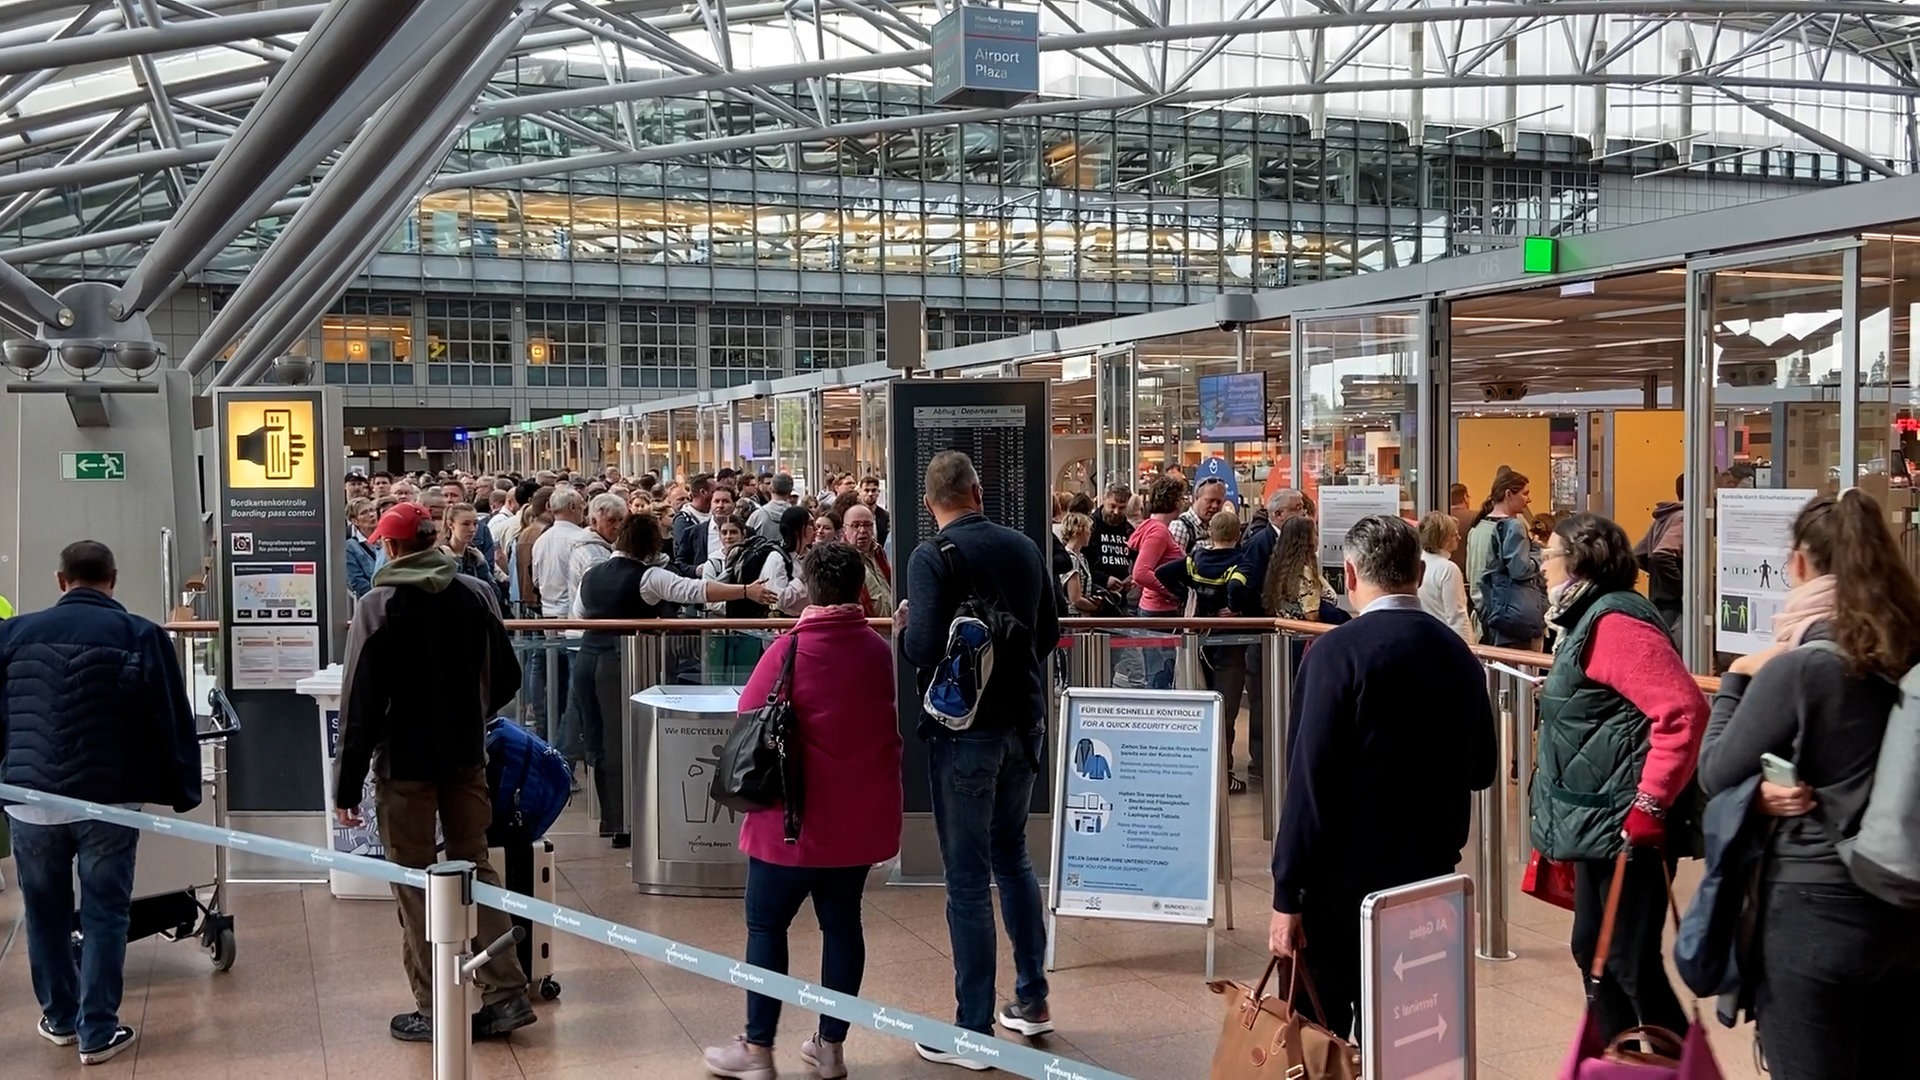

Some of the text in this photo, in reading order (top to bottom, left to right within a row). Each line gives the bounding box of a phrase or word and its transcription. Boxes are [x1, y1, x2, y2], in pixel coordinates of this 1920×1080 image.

[974, 48, 1020, 63] Airport
[976, 64, 1008, 78] Plaza
[230, 499, 307, 507] Bordkartenkontrolle
[231, 509, 316, 518] Boarding pass control
[1081, 706, 1097, 714] FÜR
[1115, 708, 1155, 716] SCHNELLE
[1157, 709, 1202, 717] KONTROLLE
[1132, 722, 1170, 730] SECURITY
[1171, 723, 1198, 731] CHECK
[729, 968, 764, 984] Hamburg Airport
[797, 989, 836, 1007] Hamburg Airport
[872, 1012, 914, 1031] Hamburg Airport
[954, 1037, 999, 1057] Hamburg Airport
